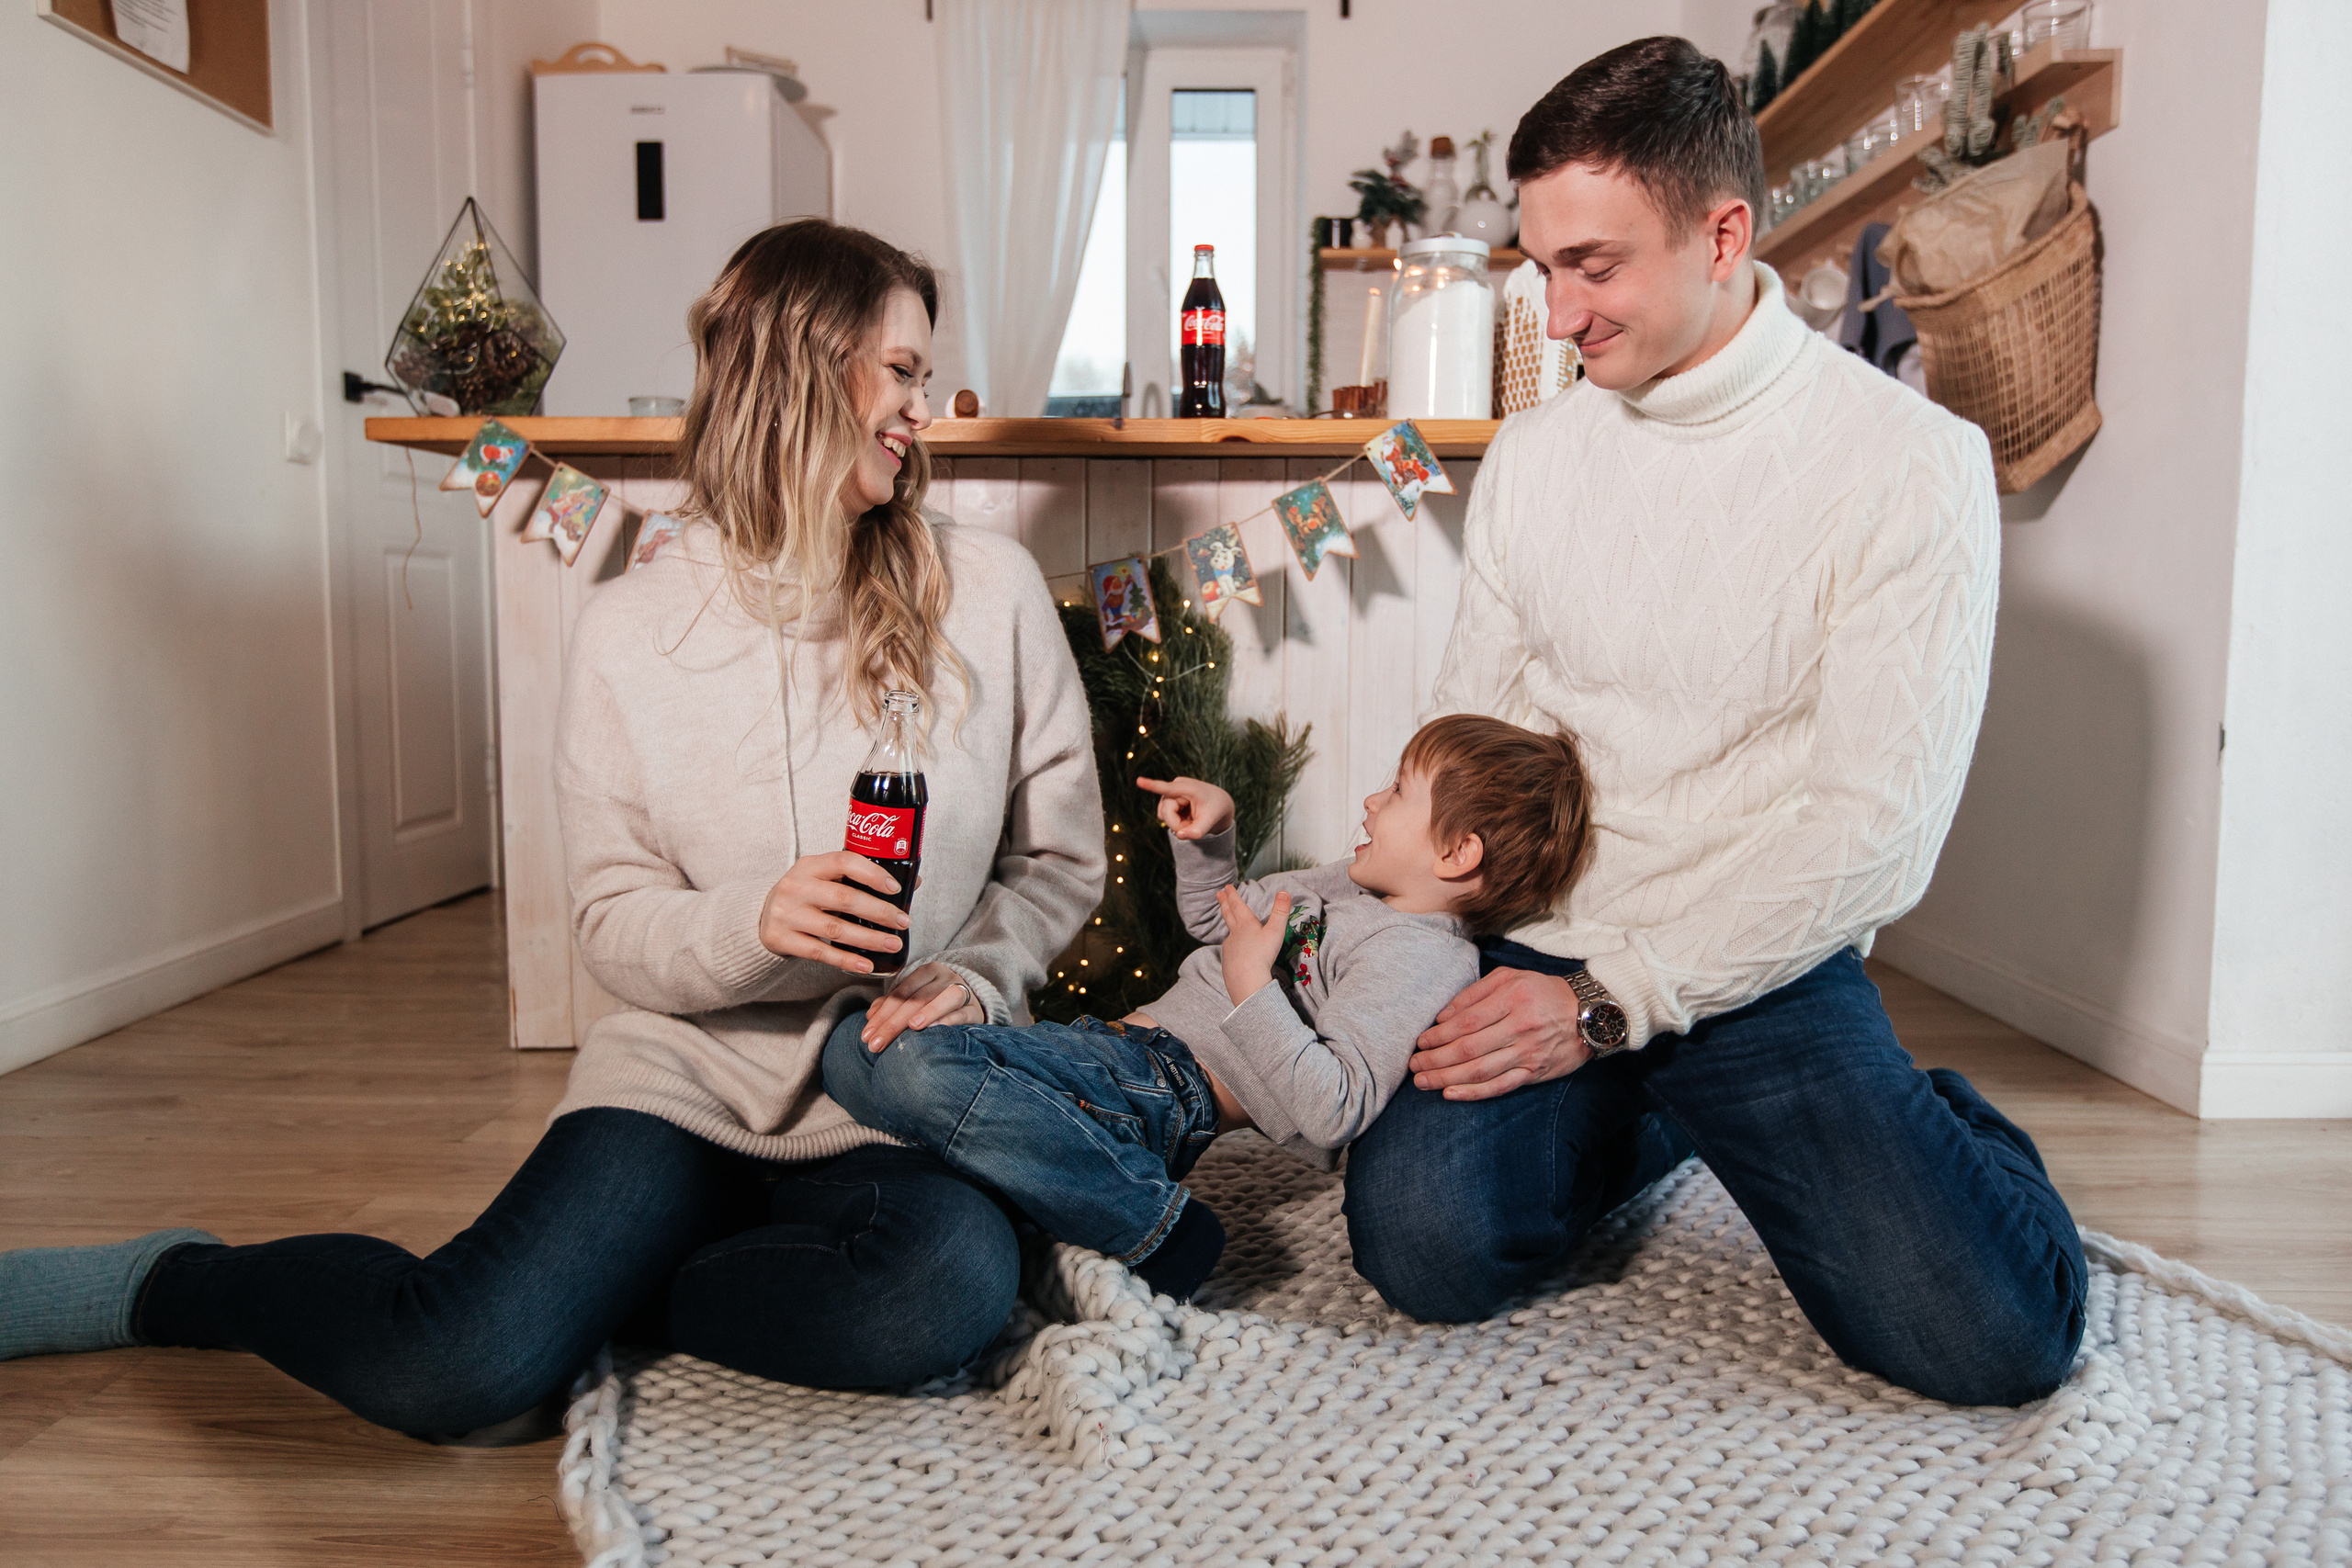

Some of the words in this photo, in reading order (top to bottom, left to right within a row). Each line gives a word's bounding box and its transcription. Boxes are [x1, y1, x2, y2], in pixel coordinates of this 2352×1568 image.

[1184, 314, 1224, 332] Coc-Cola
[847, 804, 900, 838] oca-Cola
[852, 832, 872, 842] CLASSIC
[1169, 1064, 1185, 1087] NOTHING
